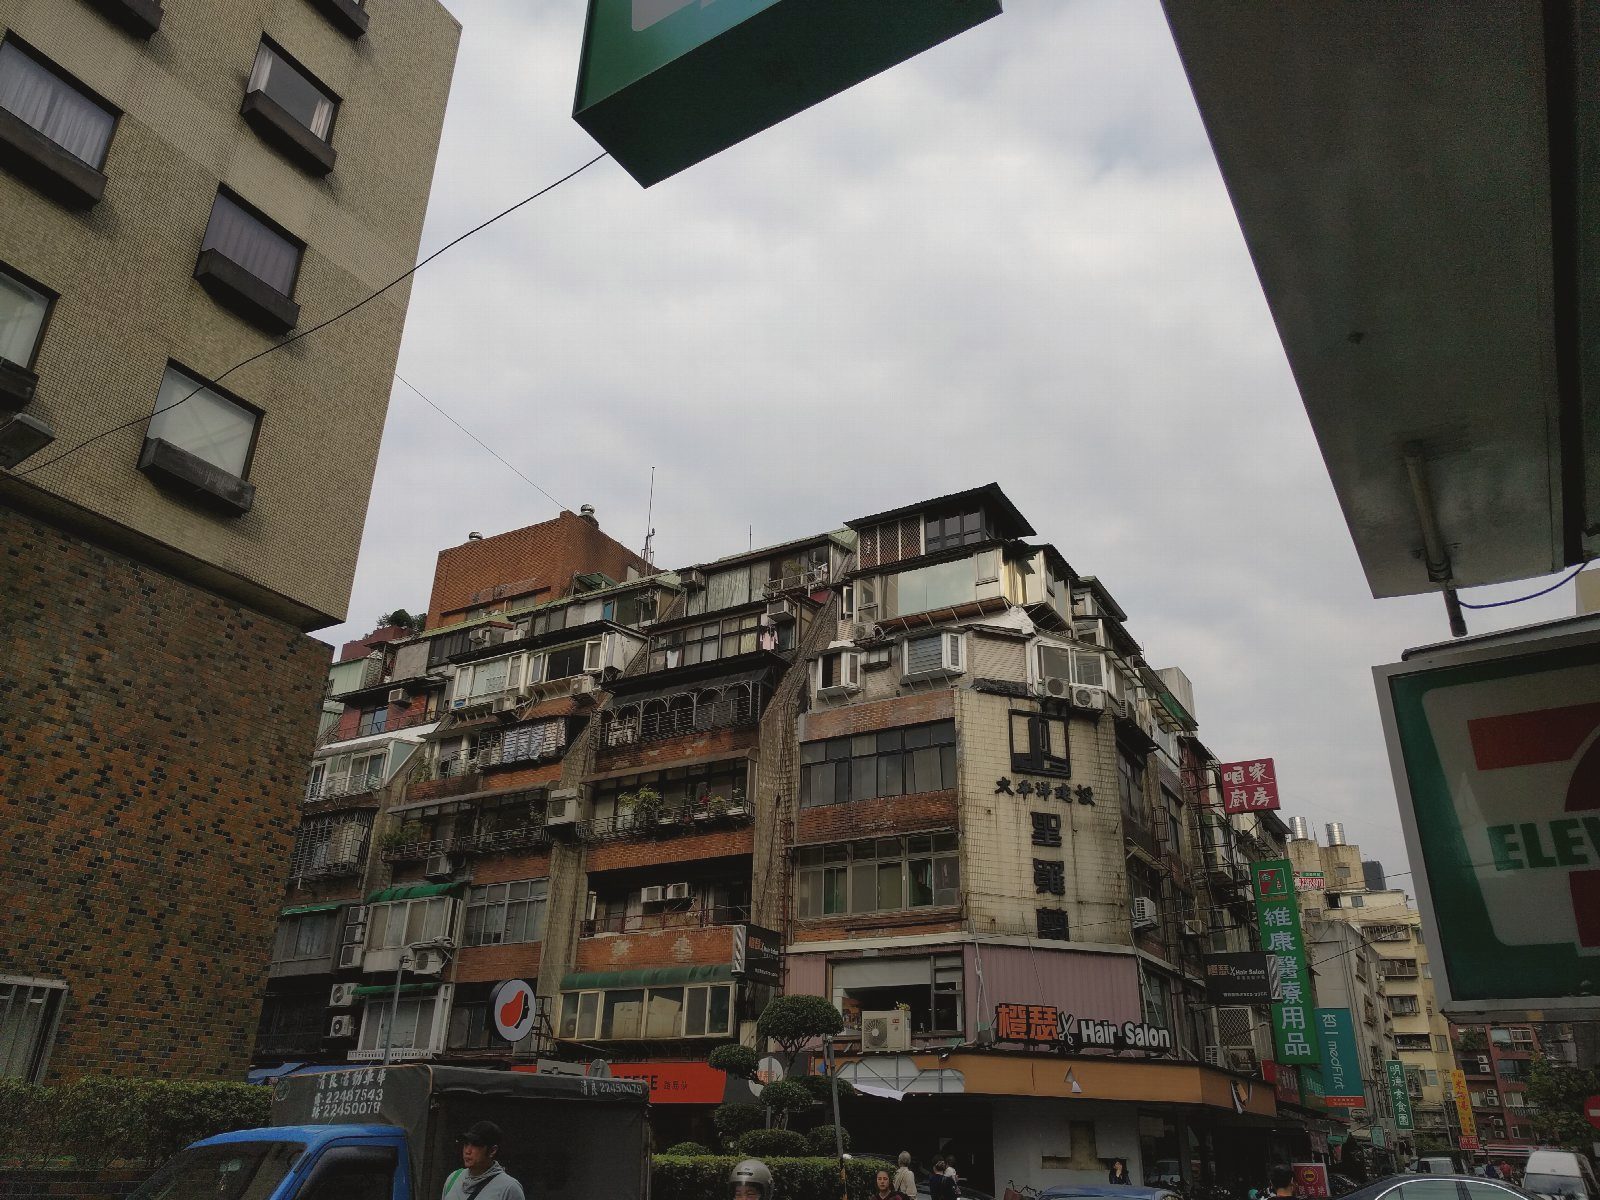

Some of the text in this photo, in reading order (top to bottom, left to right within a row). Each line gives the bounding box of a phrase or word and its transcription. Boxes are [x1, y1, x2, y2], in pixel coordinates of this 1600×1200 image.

[997, 1003, 1171, 1048] 橙瑟 Hair Salon
[325, 1088, 384, 1104] 22487543
